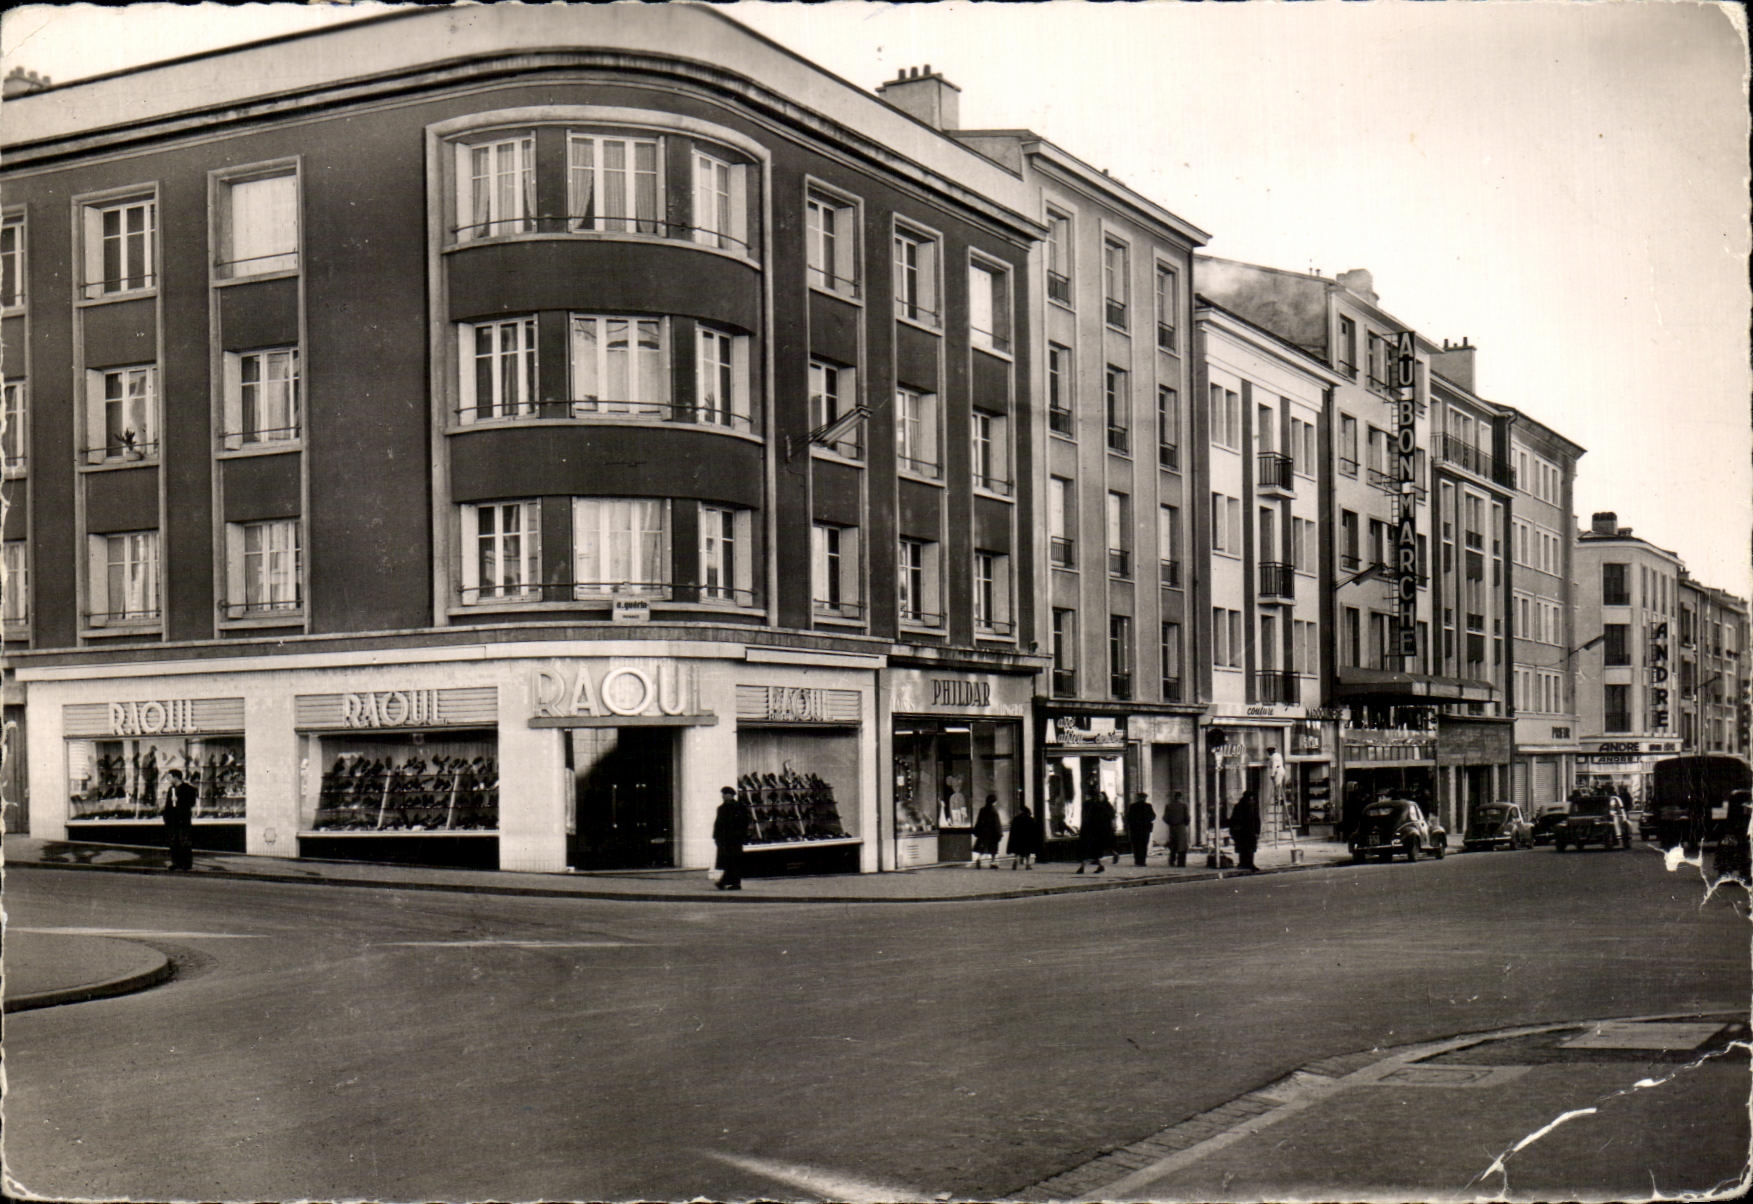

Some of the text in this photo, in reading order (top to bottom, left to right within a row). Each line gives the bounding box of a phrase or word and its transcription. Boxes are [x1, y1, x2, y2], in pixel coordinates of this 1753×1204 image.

[1399, 332, 1414, 385] AU
[1399, 401, 1414, 479] BON
[533, 662, 714, 717] RAOUL
[768, 687, 834, 721] RAOUL
[931, 679, 990, 707] PHILDAR
[108, 700, 198, 736] RAOUL
[342, 689, 448, 728] RAOUL
[1599, 742, 1640, 752] ANDRE
